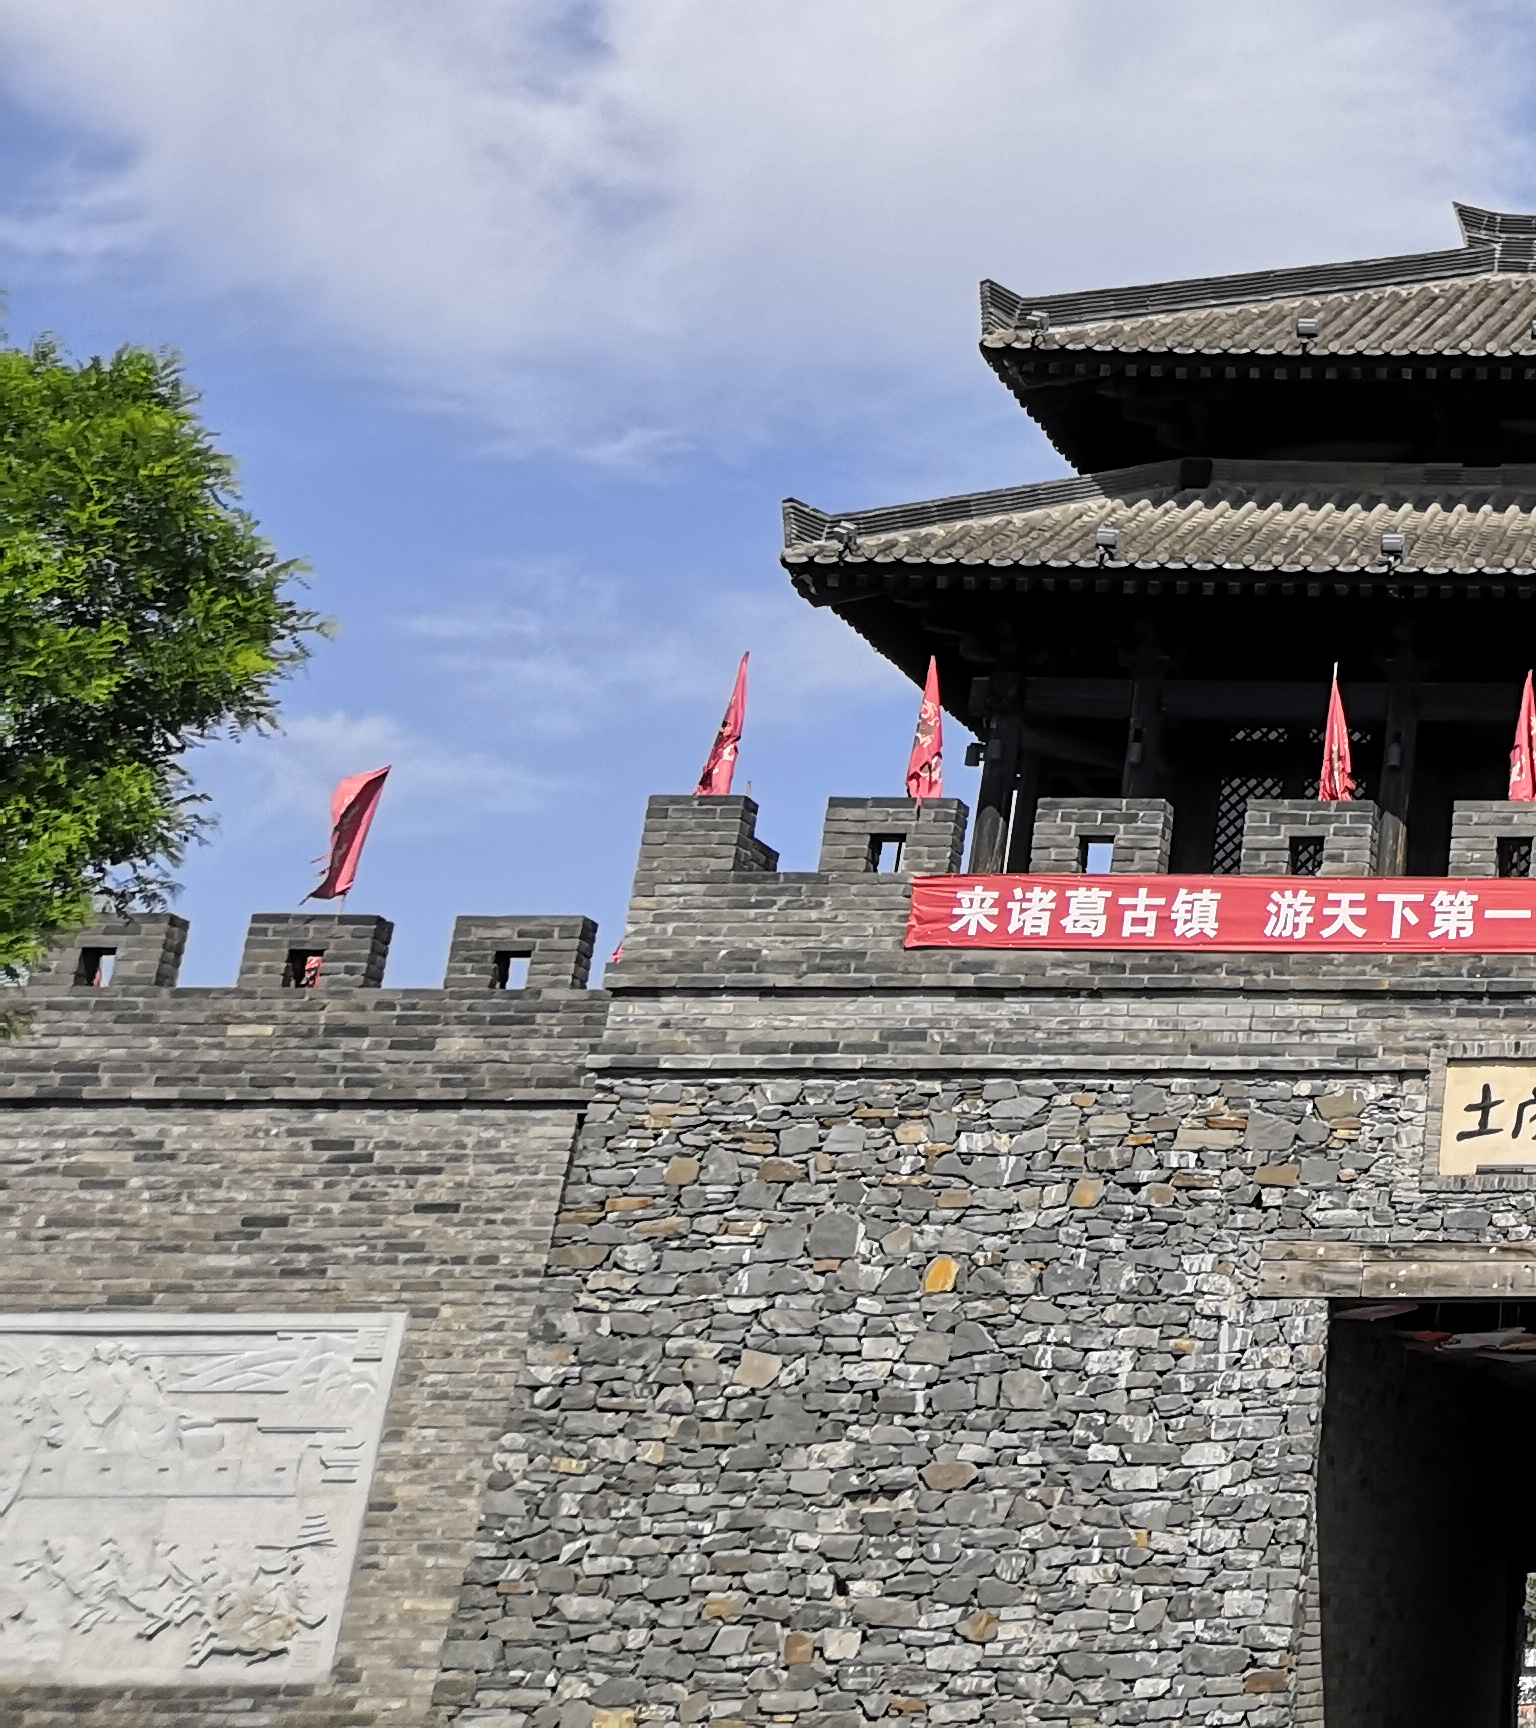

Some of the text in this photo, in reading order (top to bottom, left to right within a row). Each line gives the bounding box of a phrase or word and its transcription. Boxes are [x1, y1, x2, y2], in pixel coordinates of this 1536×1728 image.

[948, 885, 1220, 939] 来诸葛古镇
